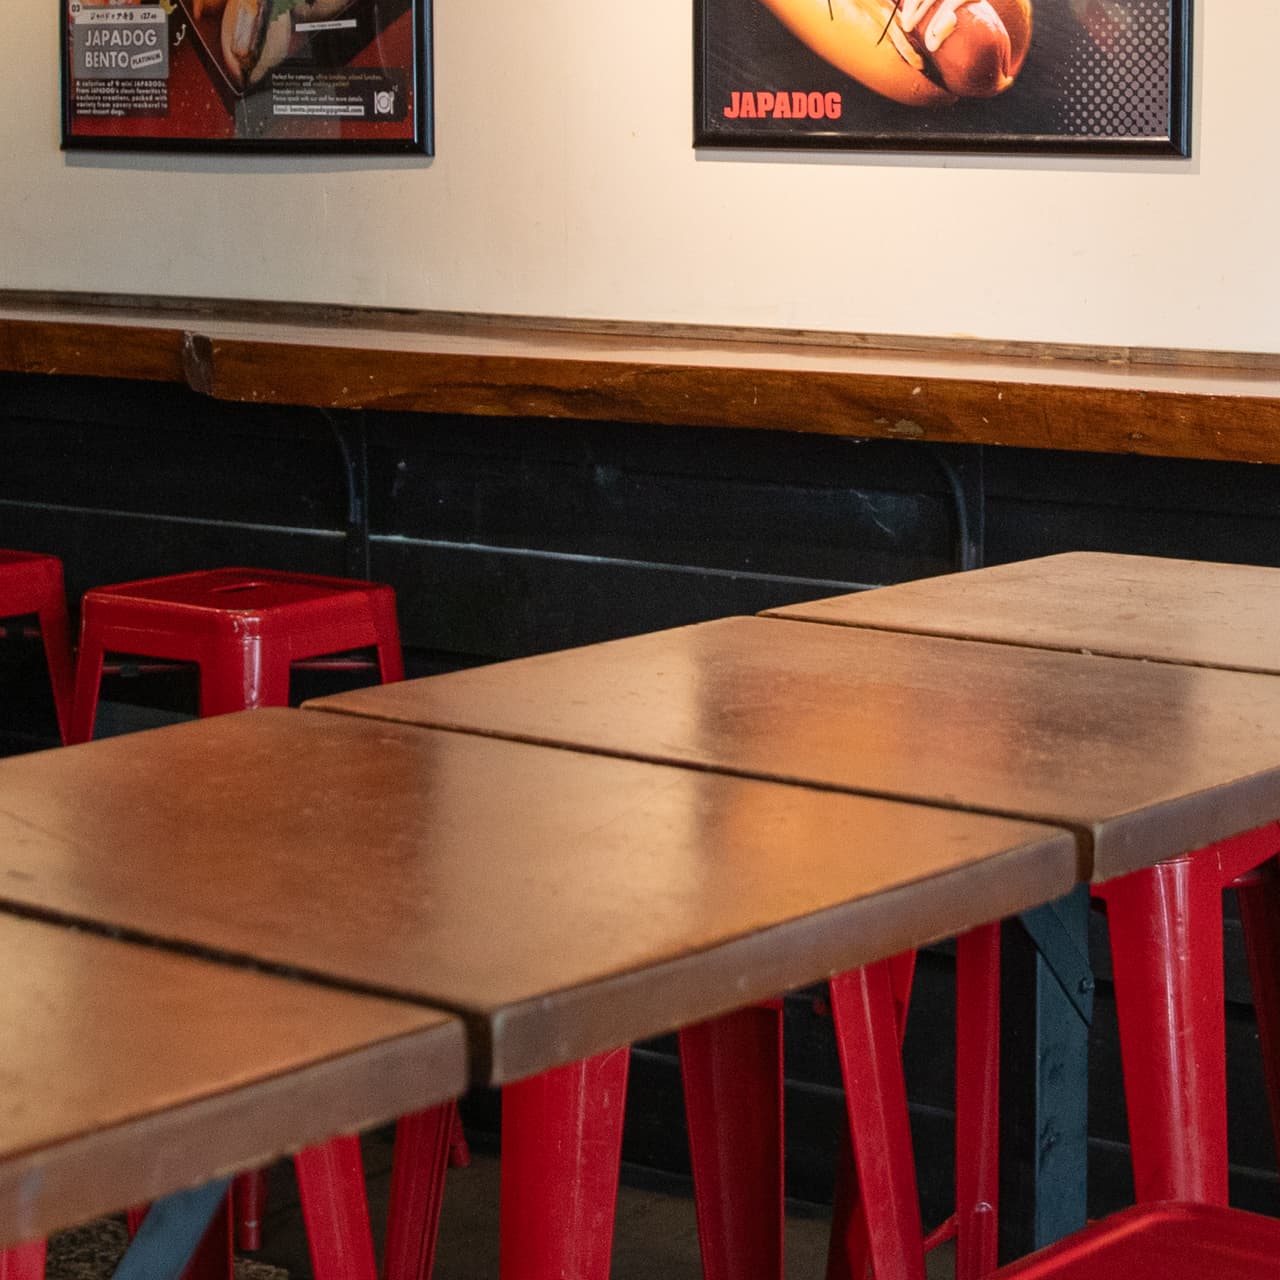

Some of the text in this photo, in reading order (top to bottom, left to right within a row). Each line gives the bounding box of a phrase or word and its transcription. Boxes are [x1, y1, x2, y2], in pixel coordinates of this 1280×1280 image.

[85, 29, 157, 46] JAPADOG
[85, 51, 129, 68] BENTO
[723, 91, 842, 119] JAPADOG
